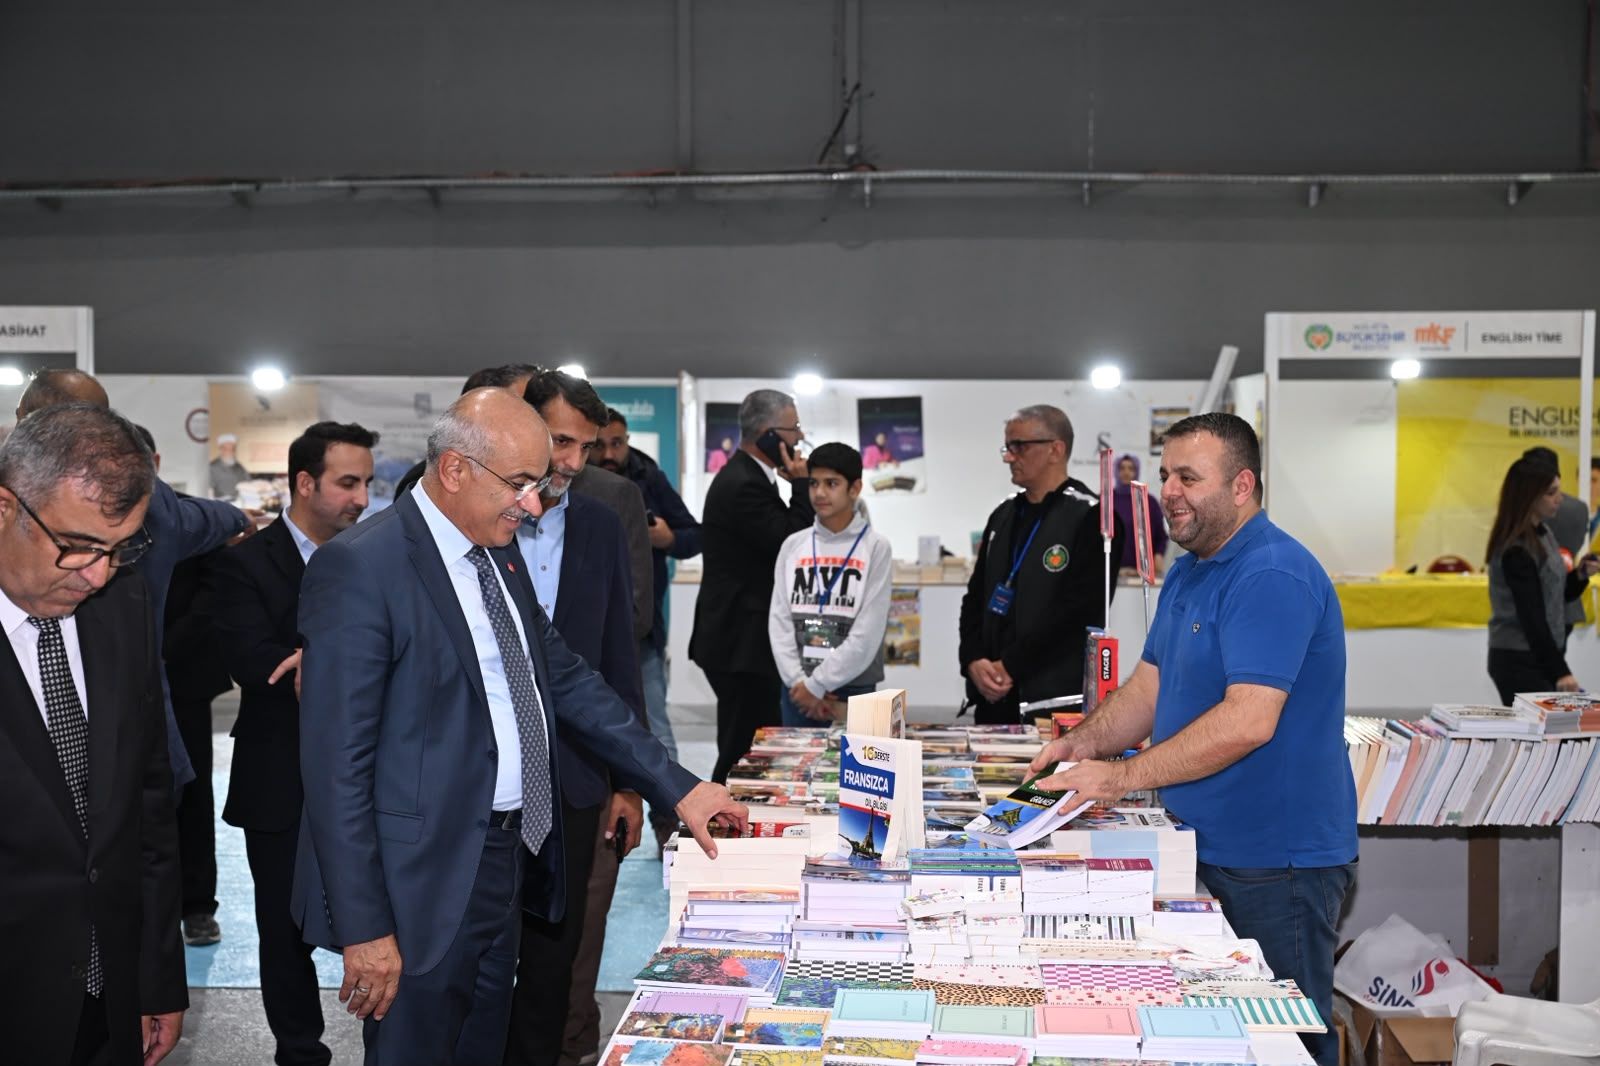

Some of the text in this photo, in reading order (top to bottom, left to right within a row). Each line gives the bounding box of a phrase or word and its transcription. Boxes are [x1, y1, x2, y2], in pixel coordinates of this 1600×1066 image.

[792, 566, 862, 607] NYC
[874, 751, 891, 763] DERSTE
[843, 768, 890, 793] FRANSIZCA
